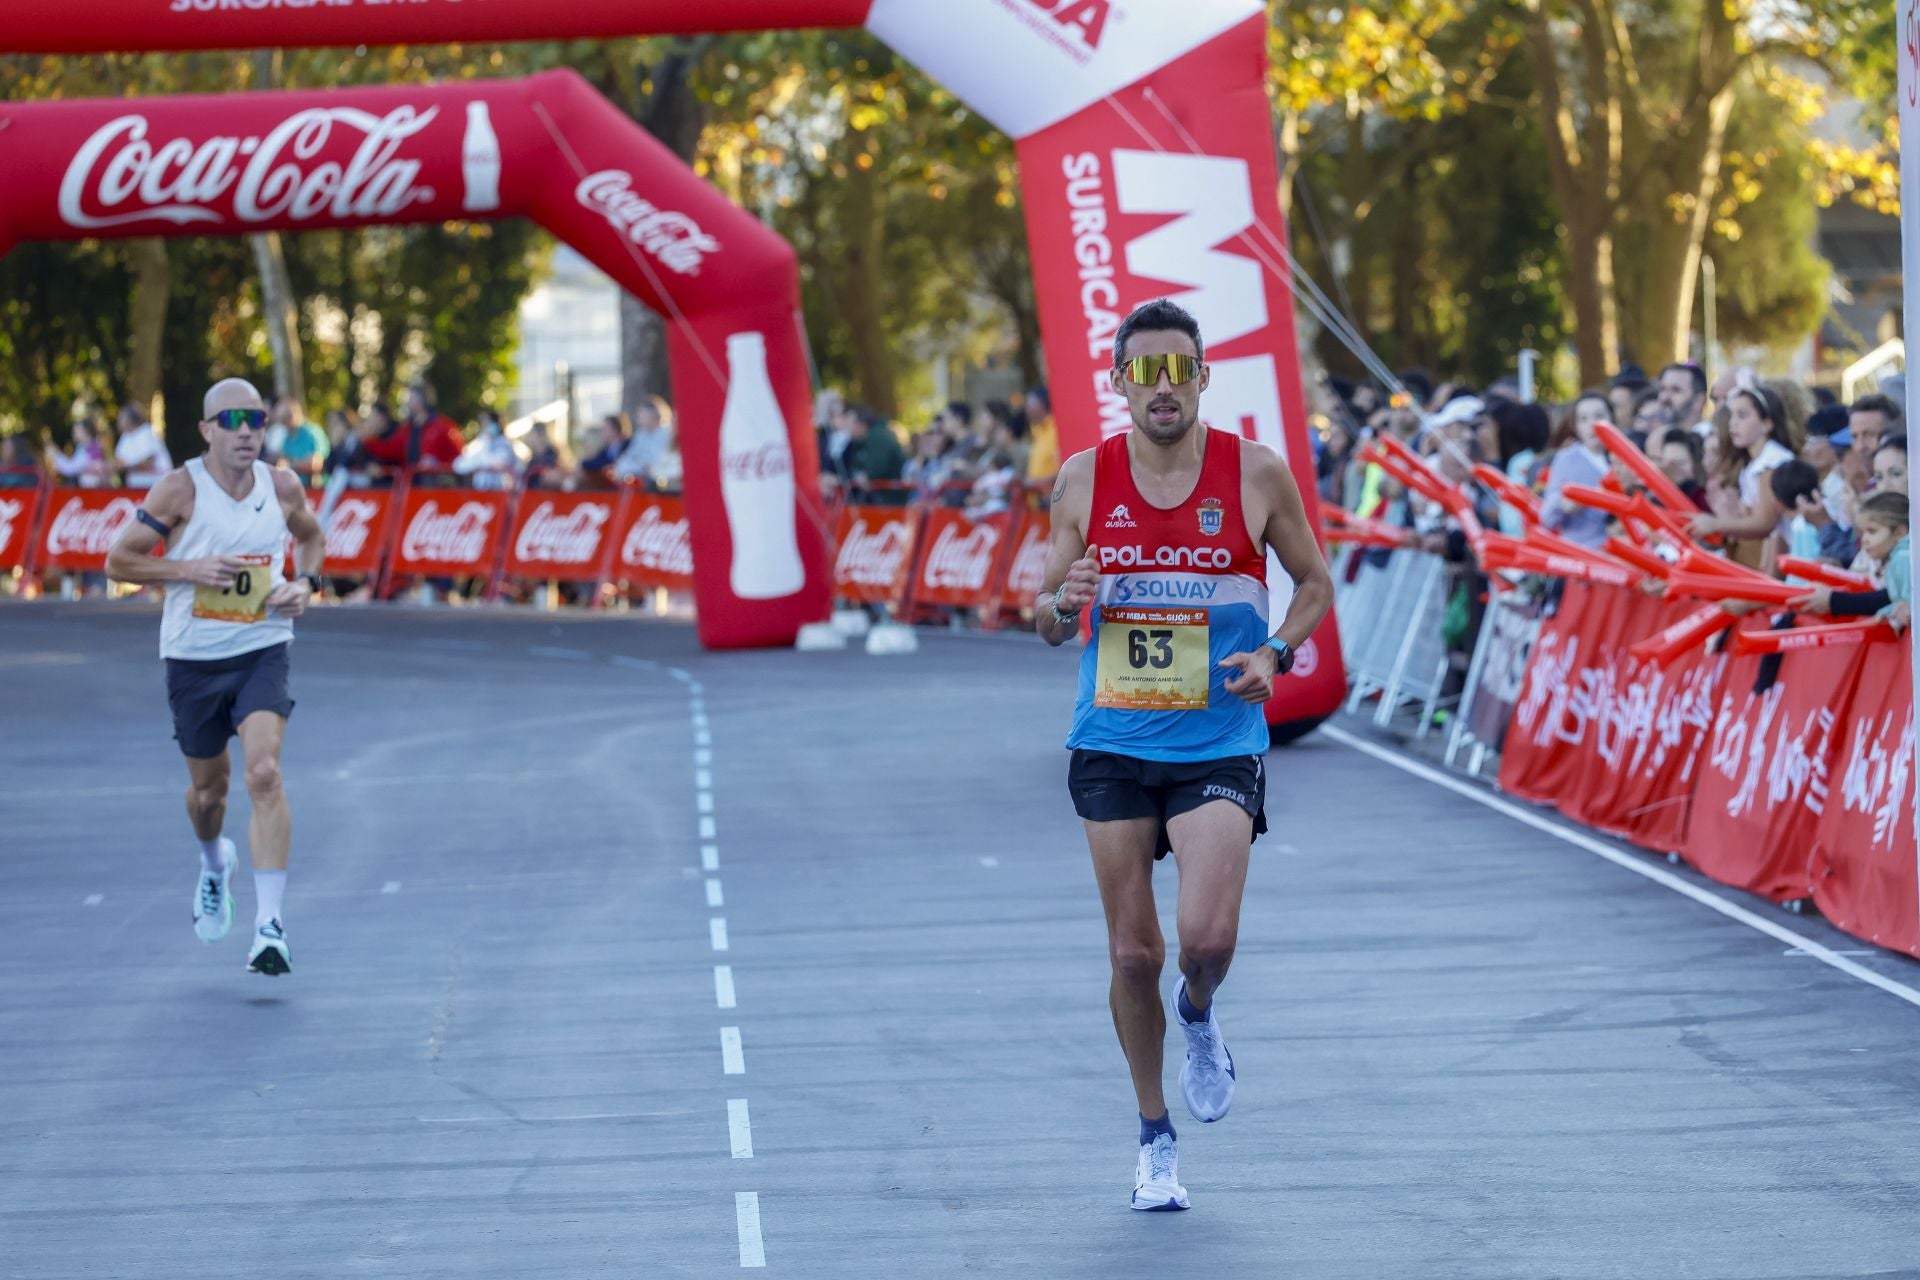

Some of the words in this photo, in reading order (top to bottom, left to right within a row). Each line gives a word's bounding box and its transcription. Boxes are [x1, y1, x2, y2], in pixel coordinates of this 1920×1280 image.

[58, 103, 440, 229] Coca-Cola
[575, 169, 721, 276] Coca-Cola
[1062, 152, 1121, 358] SURGICAL
[1135, 580, 1217, 599] SOLVAY
[1127, 613, 1147, 621] MBA
[1167, 612, 1190, 621] GIJÓN
[1129, 629, 1172, 668] 63
